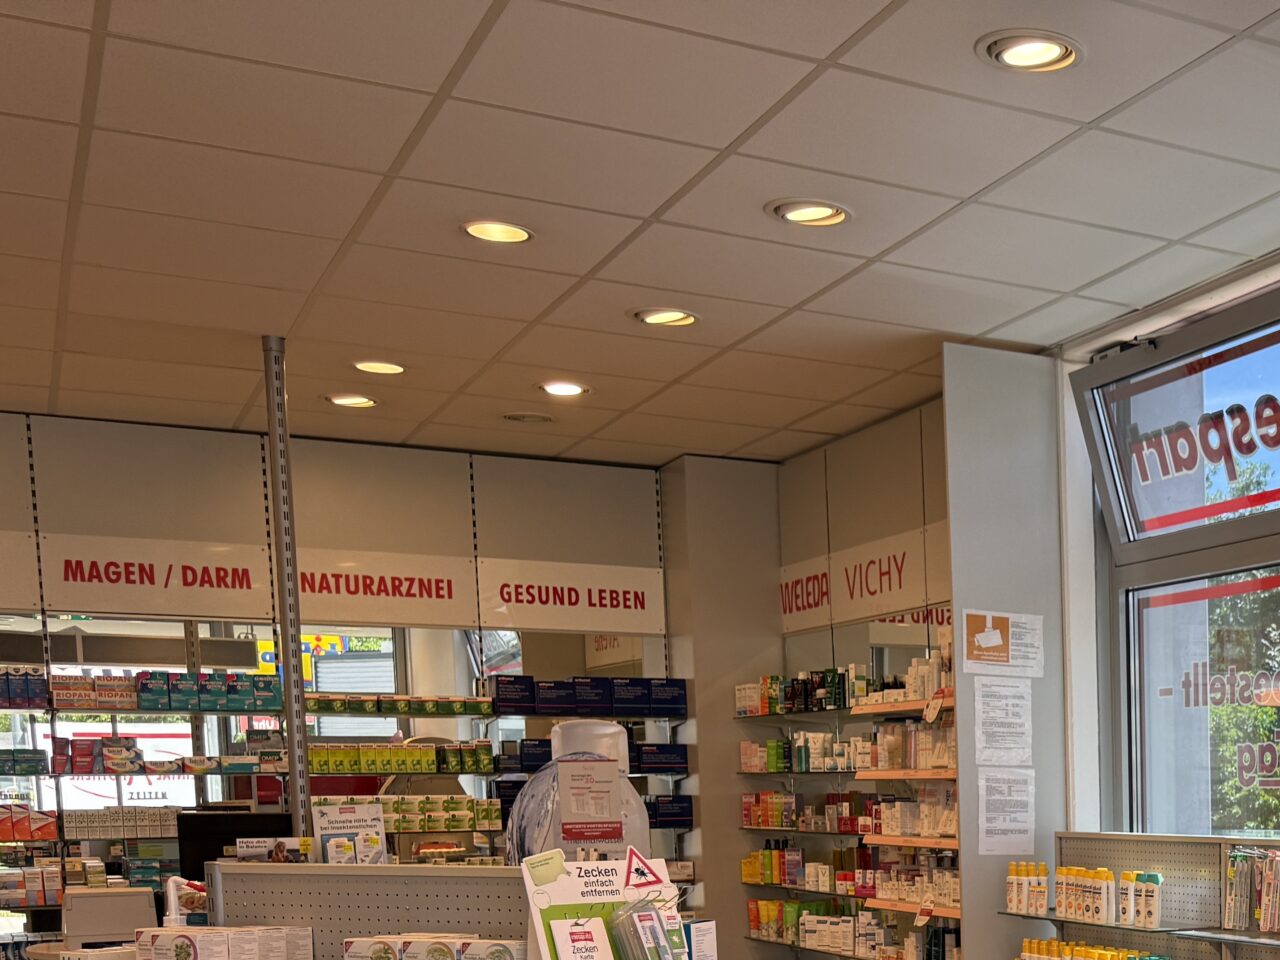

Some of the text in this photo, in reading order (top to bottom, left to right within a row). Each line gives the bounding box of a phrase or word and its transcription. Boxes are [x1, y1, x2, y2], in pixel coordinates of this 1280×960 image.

[63, 559, 252, 591] MAGEN / DARM
[845, 552, 906, 600] VICHY
[300, 572, 454, 601] NATURARZNEI
[499, 582, 647, 612] GESUND LEBEN
[780, 572, 830, 615] WELEDA
[52, 675, 87, 683] RIOPAN
[97, 675, 131, 683] RIOPAN
[576, 867, 618, 878] Zecken
[583, 878, 614, 888] einfach
[580, 888, 621, 898] entfernen
[572, 944, 598, 955] Zecken
